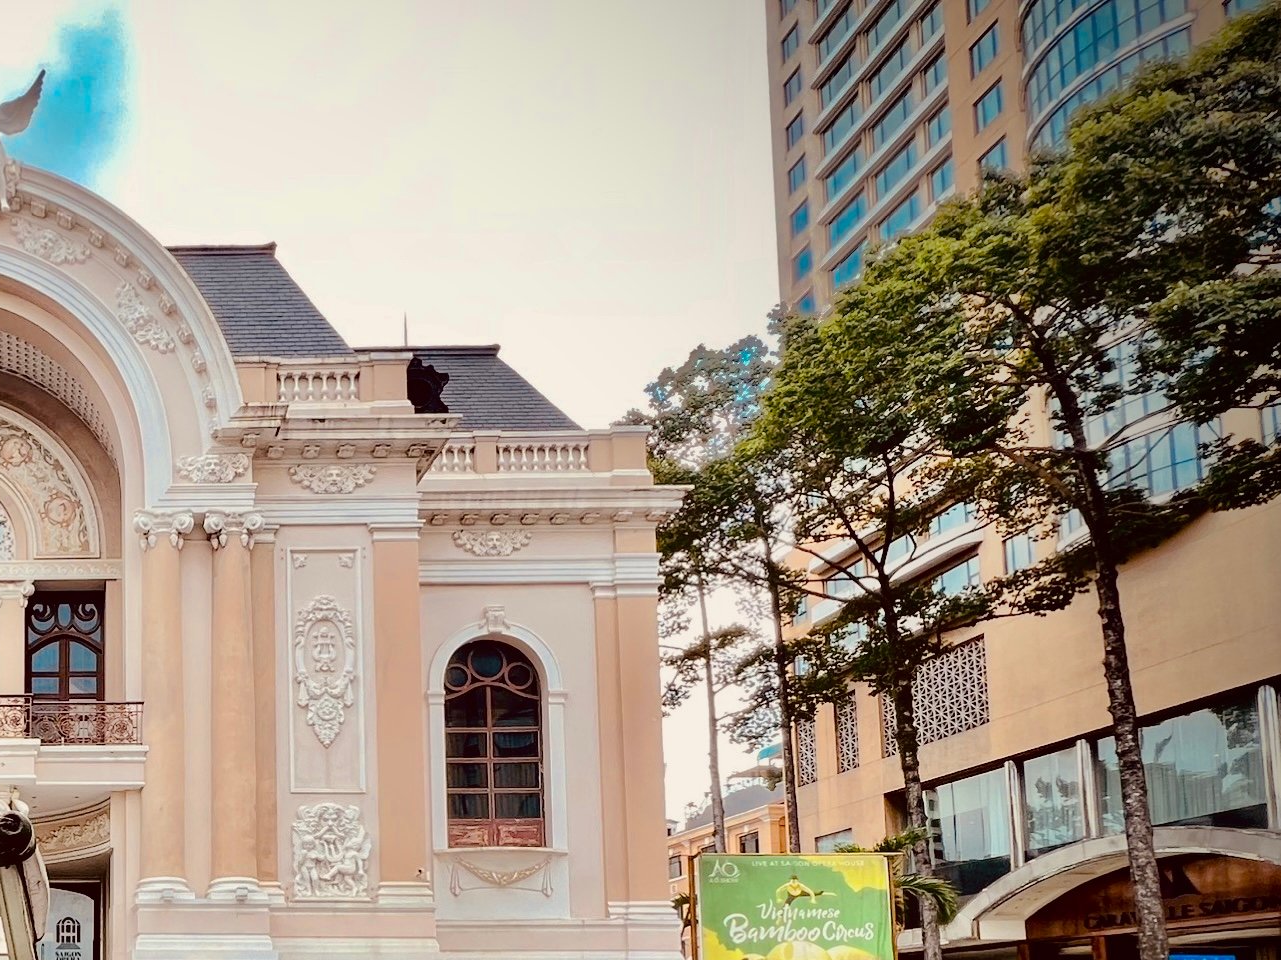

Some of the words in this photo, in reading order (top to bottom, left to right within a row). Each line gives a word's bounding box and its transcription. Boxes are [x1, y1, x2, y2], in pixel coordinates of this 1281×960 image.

[756, 899, 840, 921] Vietnamese
[723, 913, 820, 944] Bamboo
[822, 921, 874, 942] Circus
